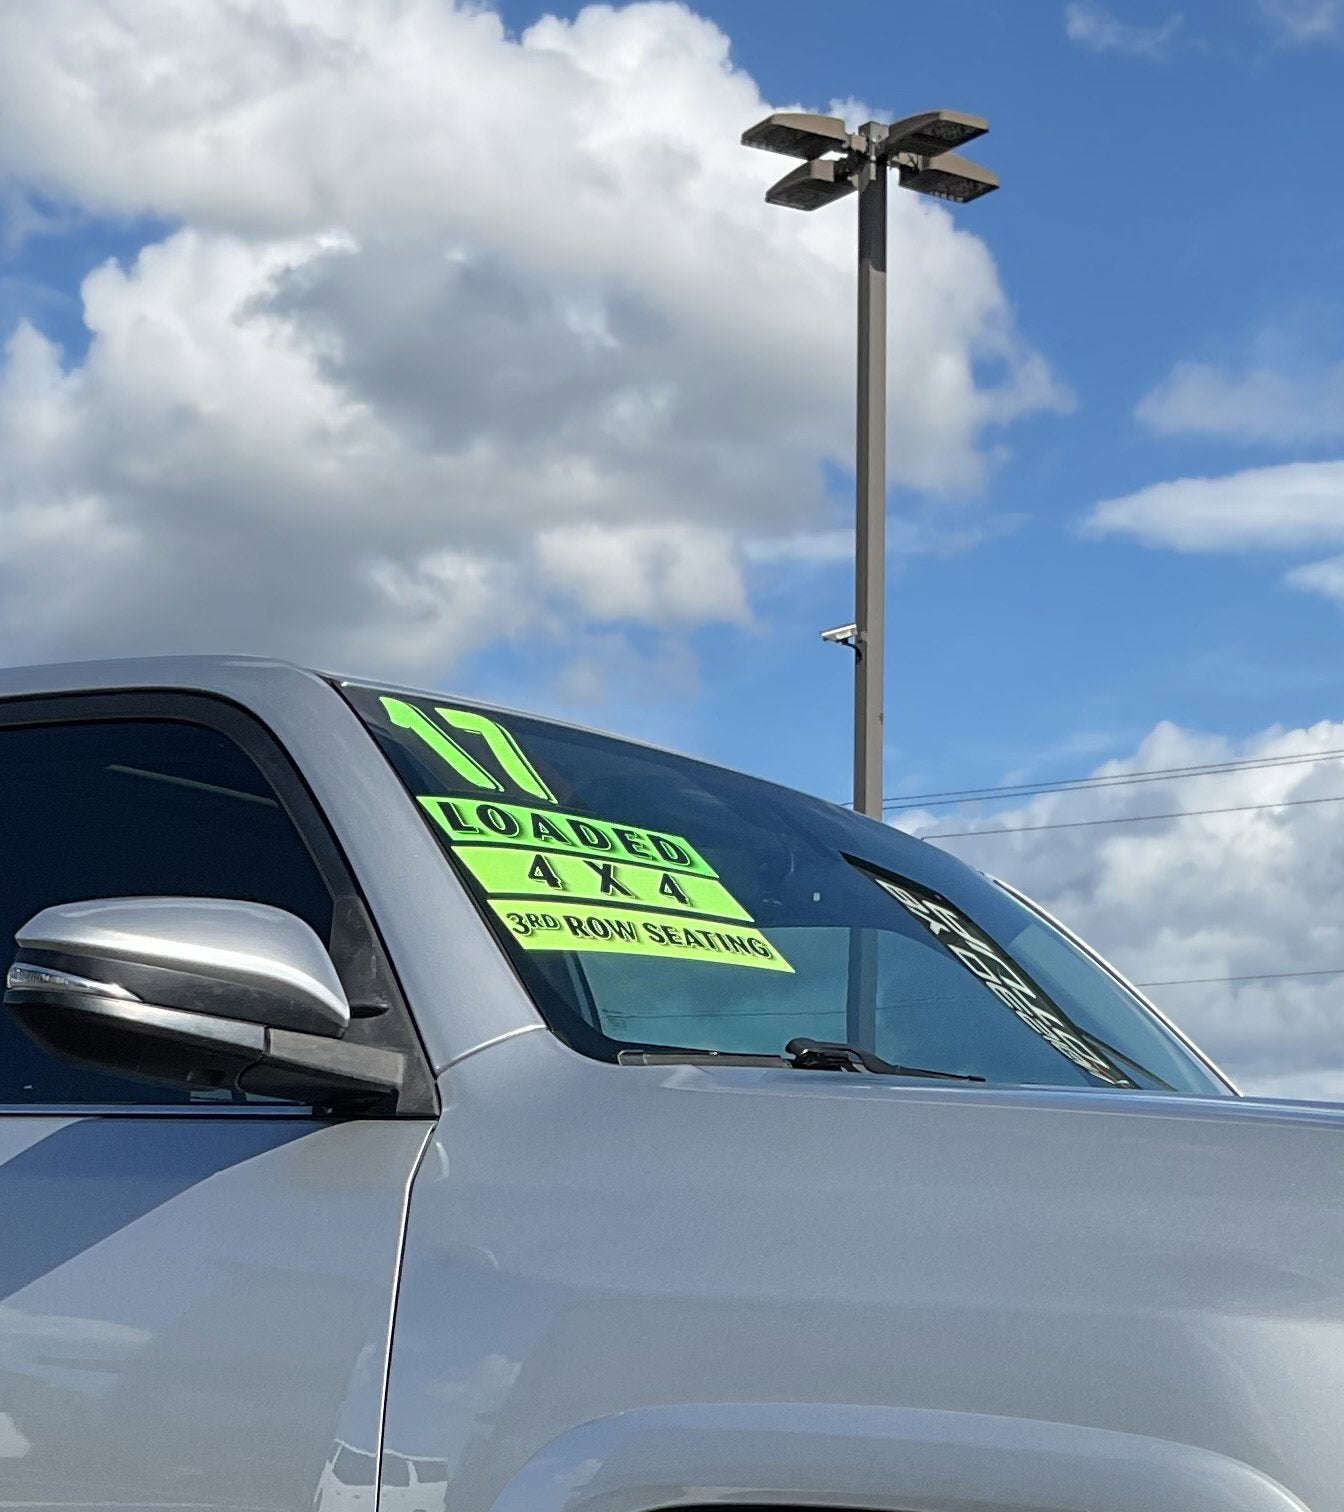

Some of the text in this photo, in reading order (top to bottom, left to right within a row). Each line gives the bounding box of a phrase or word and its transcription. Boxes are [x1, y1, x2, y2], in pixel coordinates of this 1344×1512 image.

[379, 696, 558, 804] 17
[437, 802, 692, 867] LOADED
[506, 912, 772, 958] 3RD ROW SEATING
